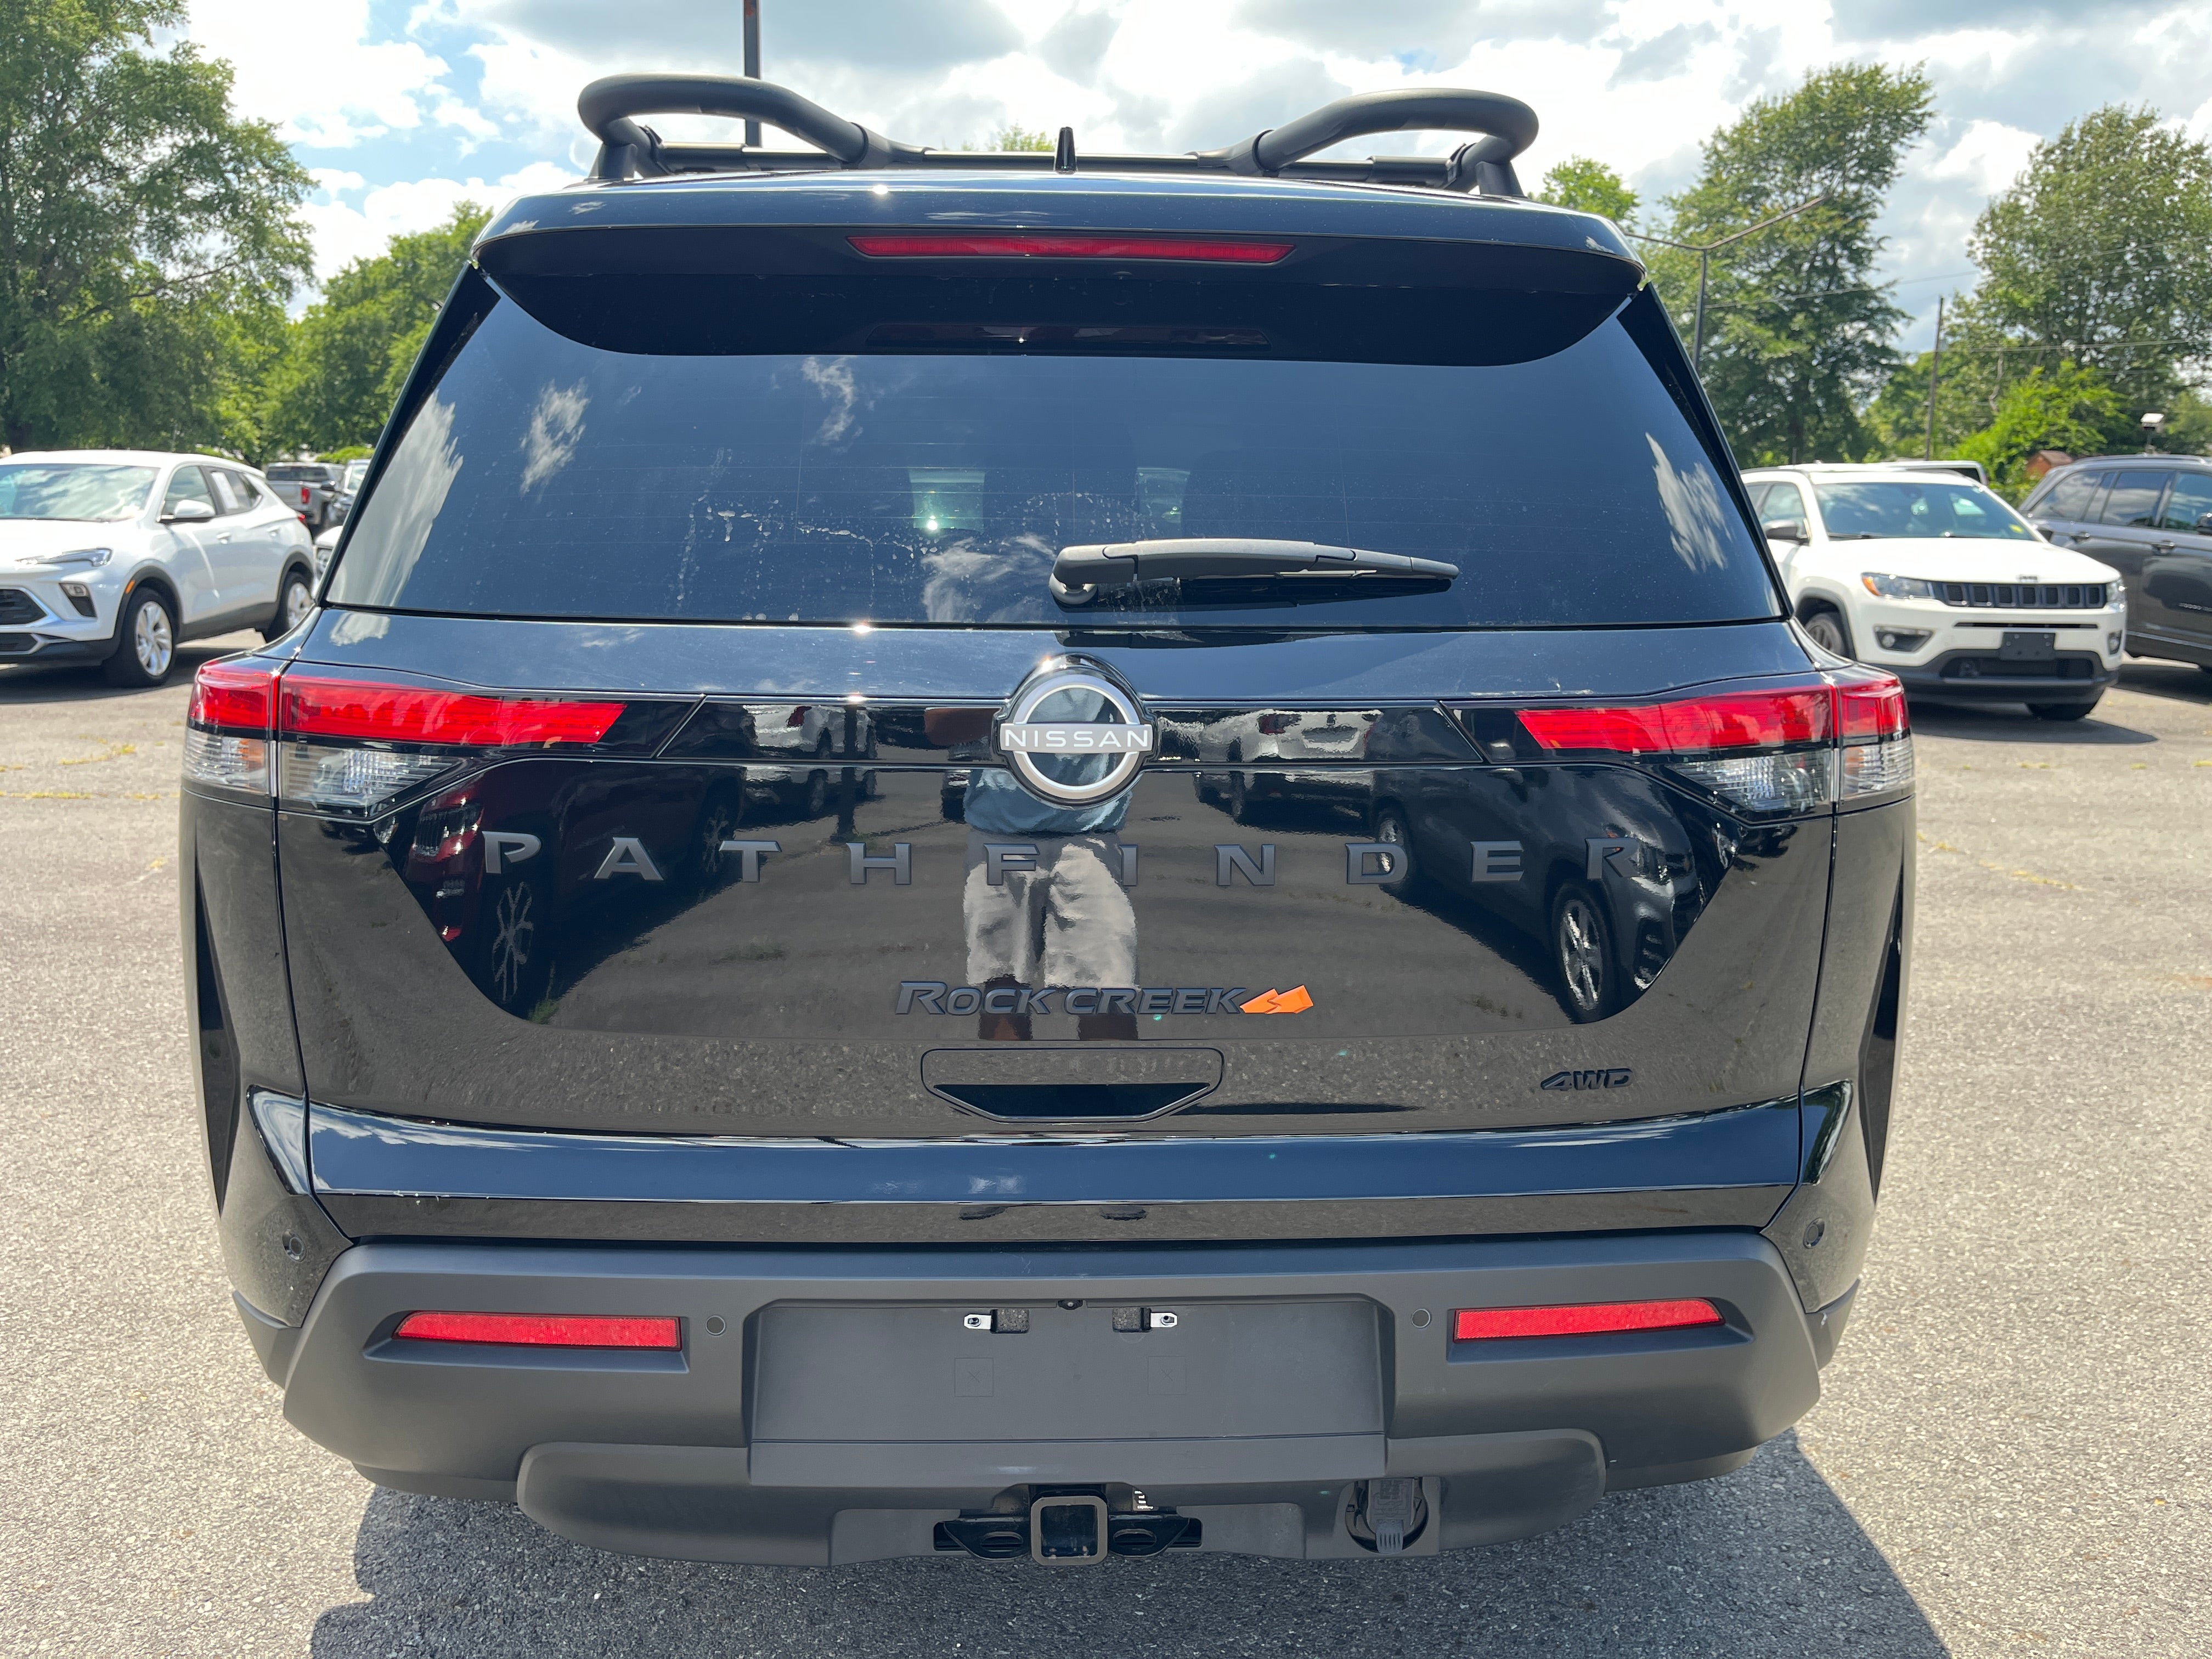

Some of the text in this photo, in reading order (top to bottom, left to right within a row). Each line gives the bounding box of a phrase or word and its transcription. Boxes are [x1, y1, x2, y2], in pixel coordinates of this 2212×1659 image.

[1004, 729, 1148, 748] NISSAN
[482, 830, 1640, 887] PATHFINDER
[895, 981, 1247, 1015] ROCK CREEK
[1541, 1068, 1633, 1091] 4WD
